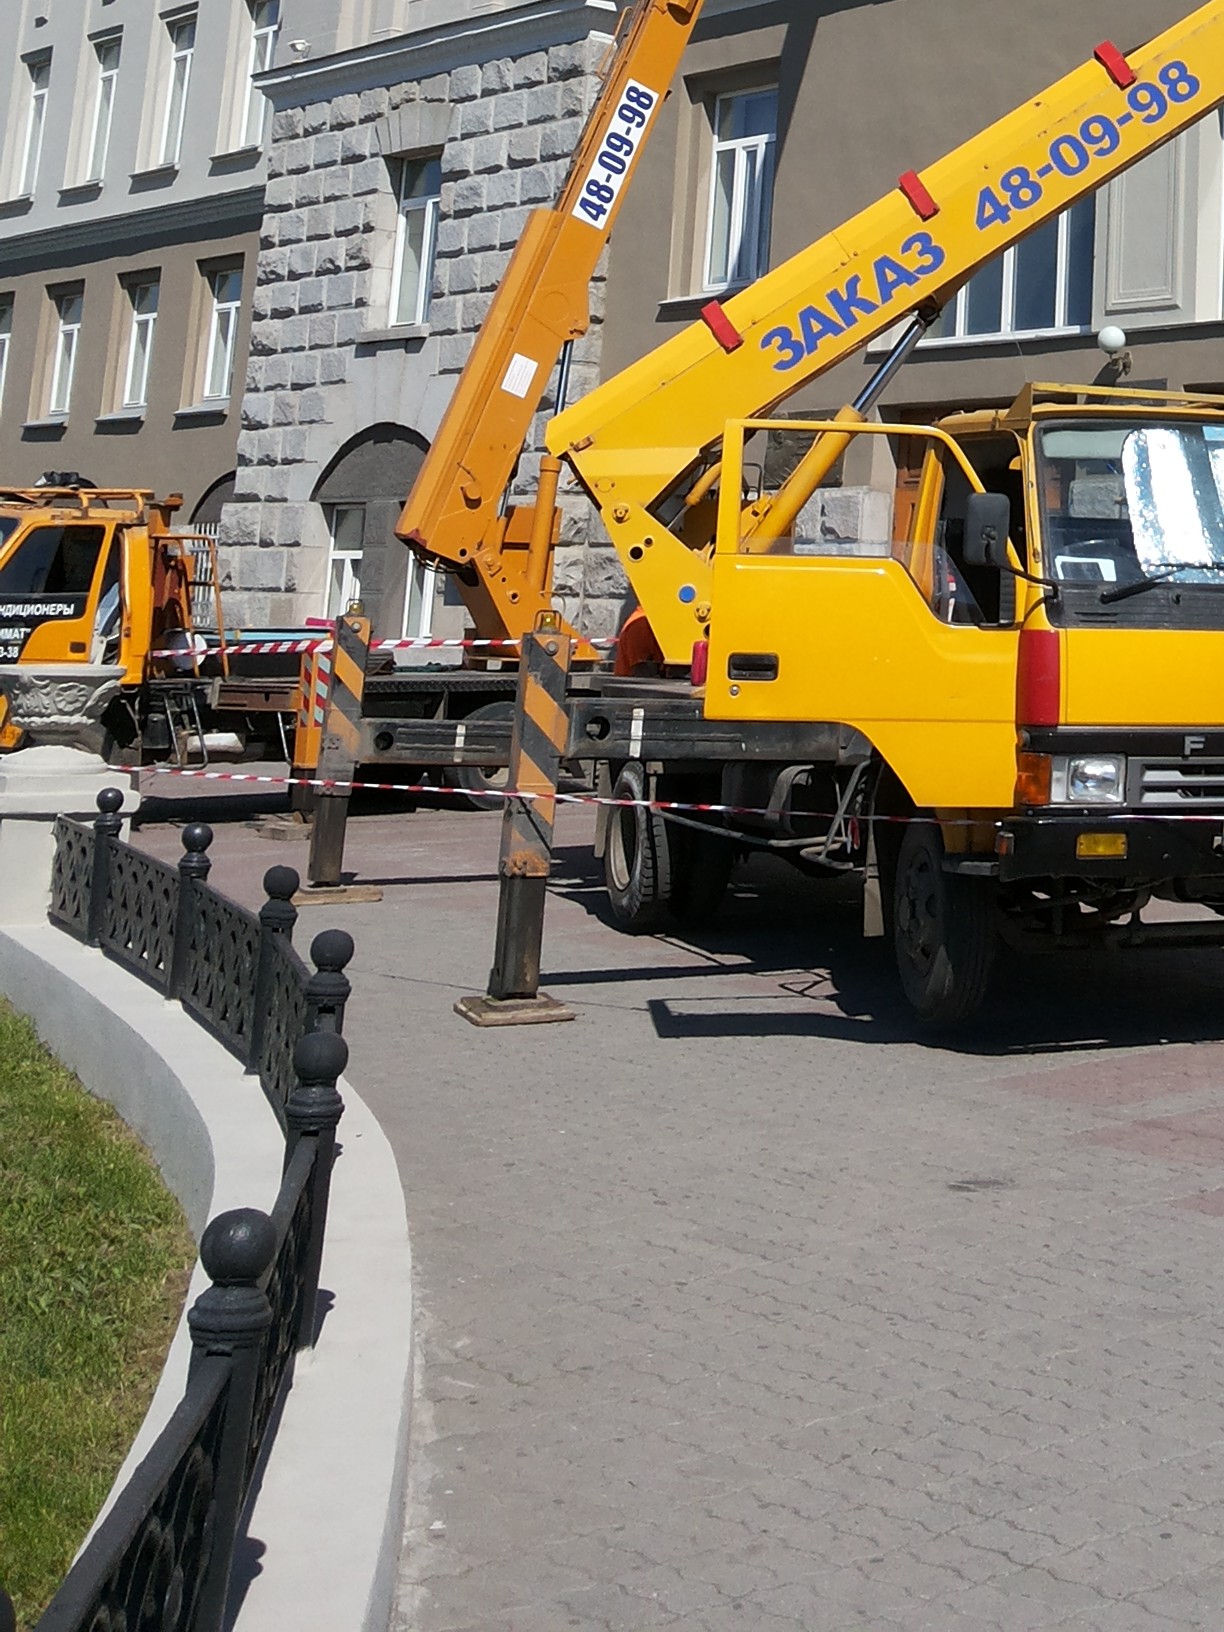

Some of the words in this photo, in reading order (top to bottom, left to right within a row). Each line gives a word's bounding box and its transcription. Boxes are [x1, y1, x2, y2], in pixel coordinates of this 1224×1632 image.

[579, 85, 654, 222] 48-09-98
[760, 232, 945, 371] ЗАКАЗ
[974, 60, 1200, 231] 48-09-98
